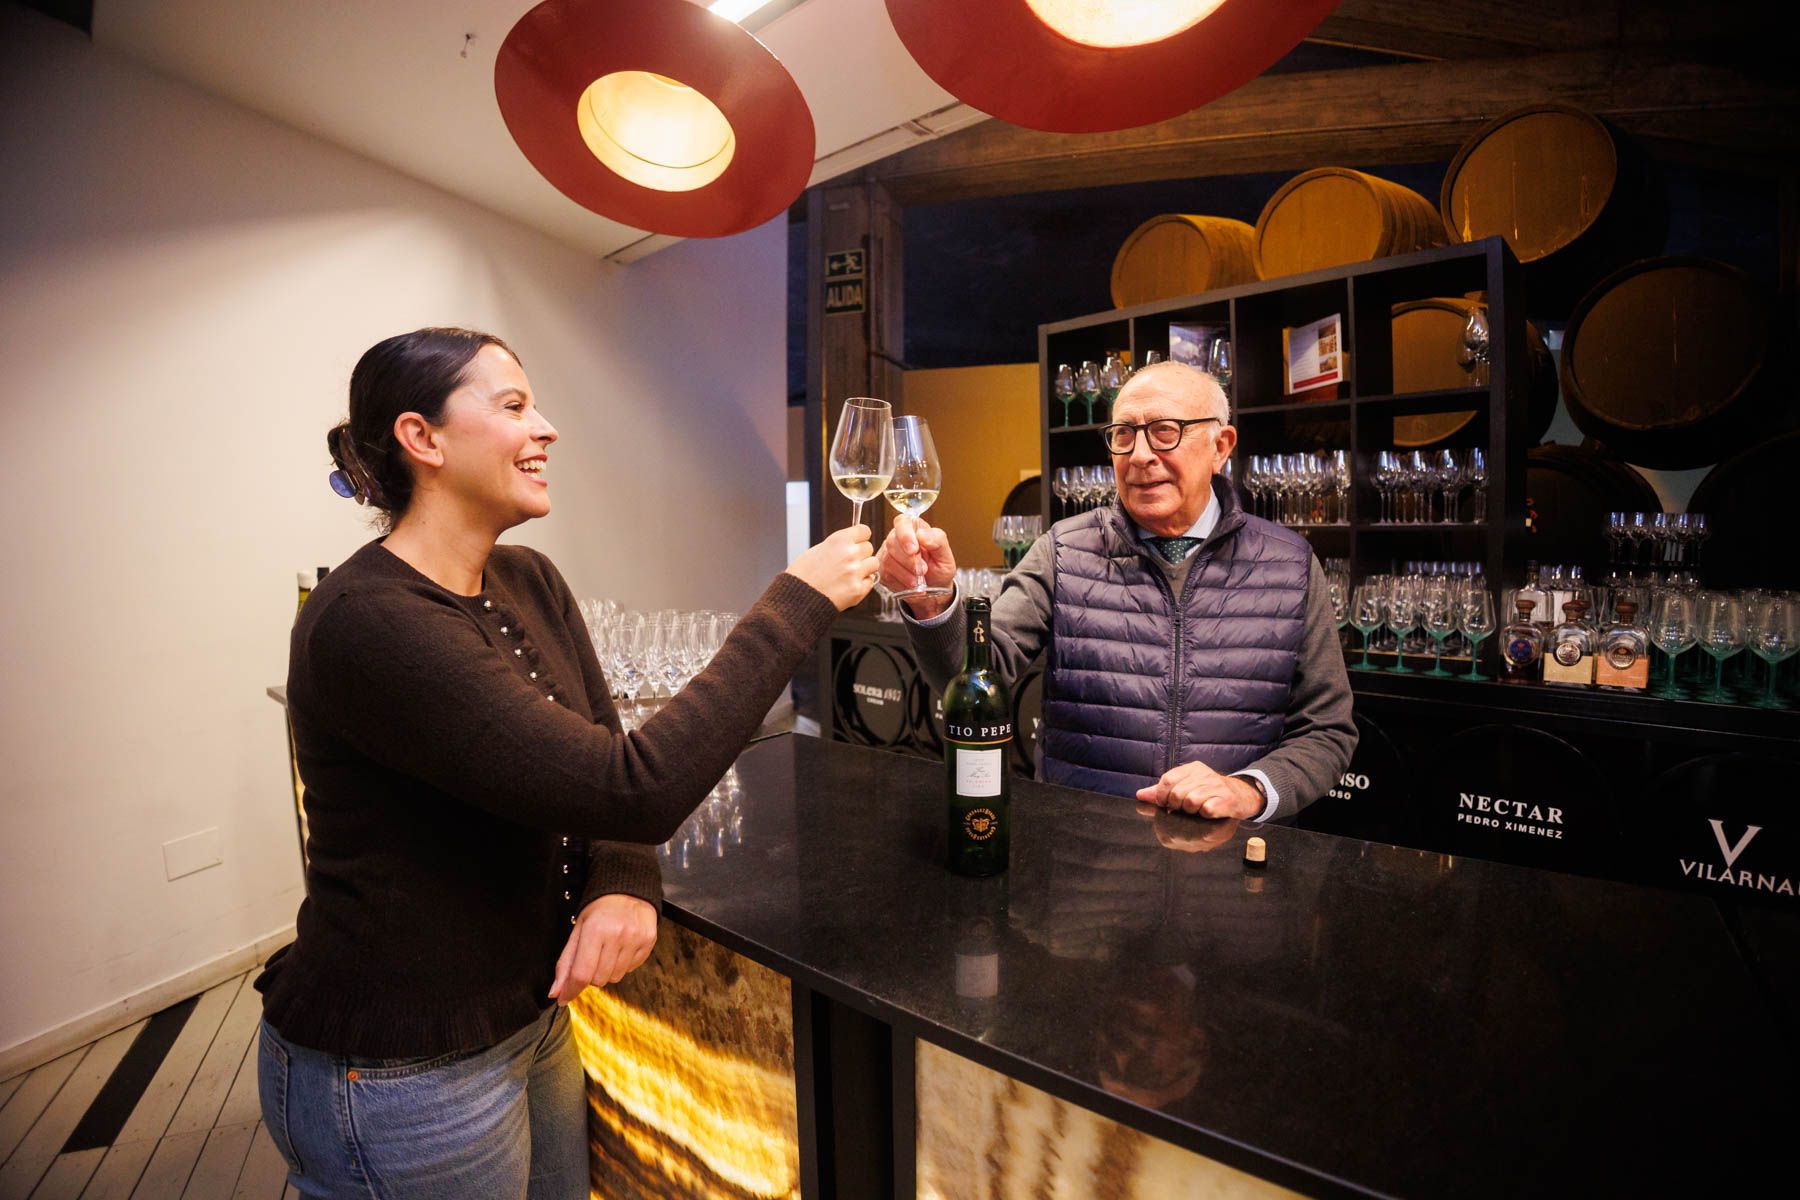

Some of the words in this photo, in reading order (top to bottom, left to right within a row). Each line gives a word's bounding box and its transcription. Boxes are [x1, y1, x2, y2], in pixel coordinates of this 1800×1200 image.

[949, 724, 973, 737] TIO
[981, 723, 1012, 737] PEPE
[1458, 792, 1564, 825] NECTAR
[1457, 812, 1500, 828] PEDRO
[1505, 821, 1563, 840] XIMENEZ
[1707, 818, 1763, 868] V
[1679, 858, 1800, 897] VILARNA
